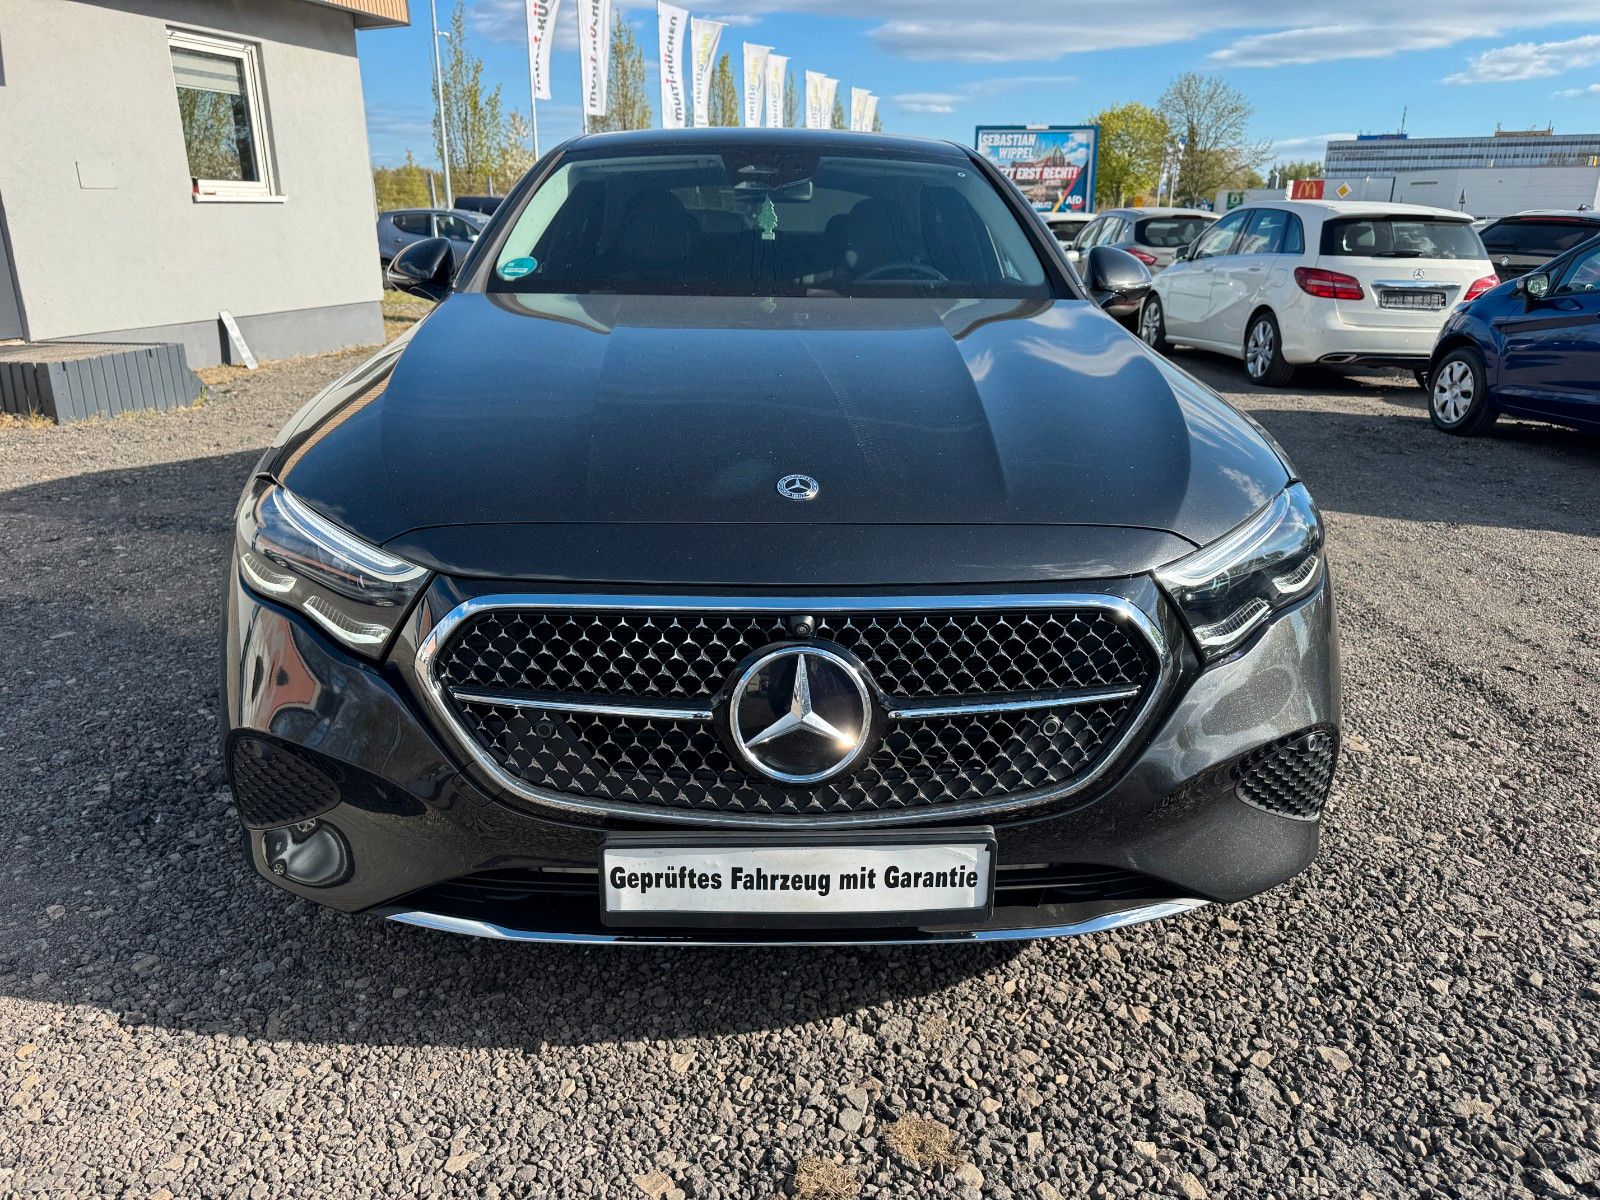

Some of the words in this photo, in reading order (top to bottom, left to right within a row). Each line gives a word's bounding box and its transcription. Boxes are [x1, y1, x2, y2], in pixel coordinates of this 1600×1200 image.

[981, 133, 1037, 146] SEBASTIAN
[998, 146, 1034, 159] WIPPEL
[1015, 166, 1042, 180] ERST
[1042, 166, 1078, 180] RECHT!
[1066, 195, 1083, 205] AfD
[610, 865, 722, 893] Geprüftes
[731, 866, 831, 896] Fahrzeug
[839, 866, 877, 889] mit
[884, 865, 978, 888] Garantie
